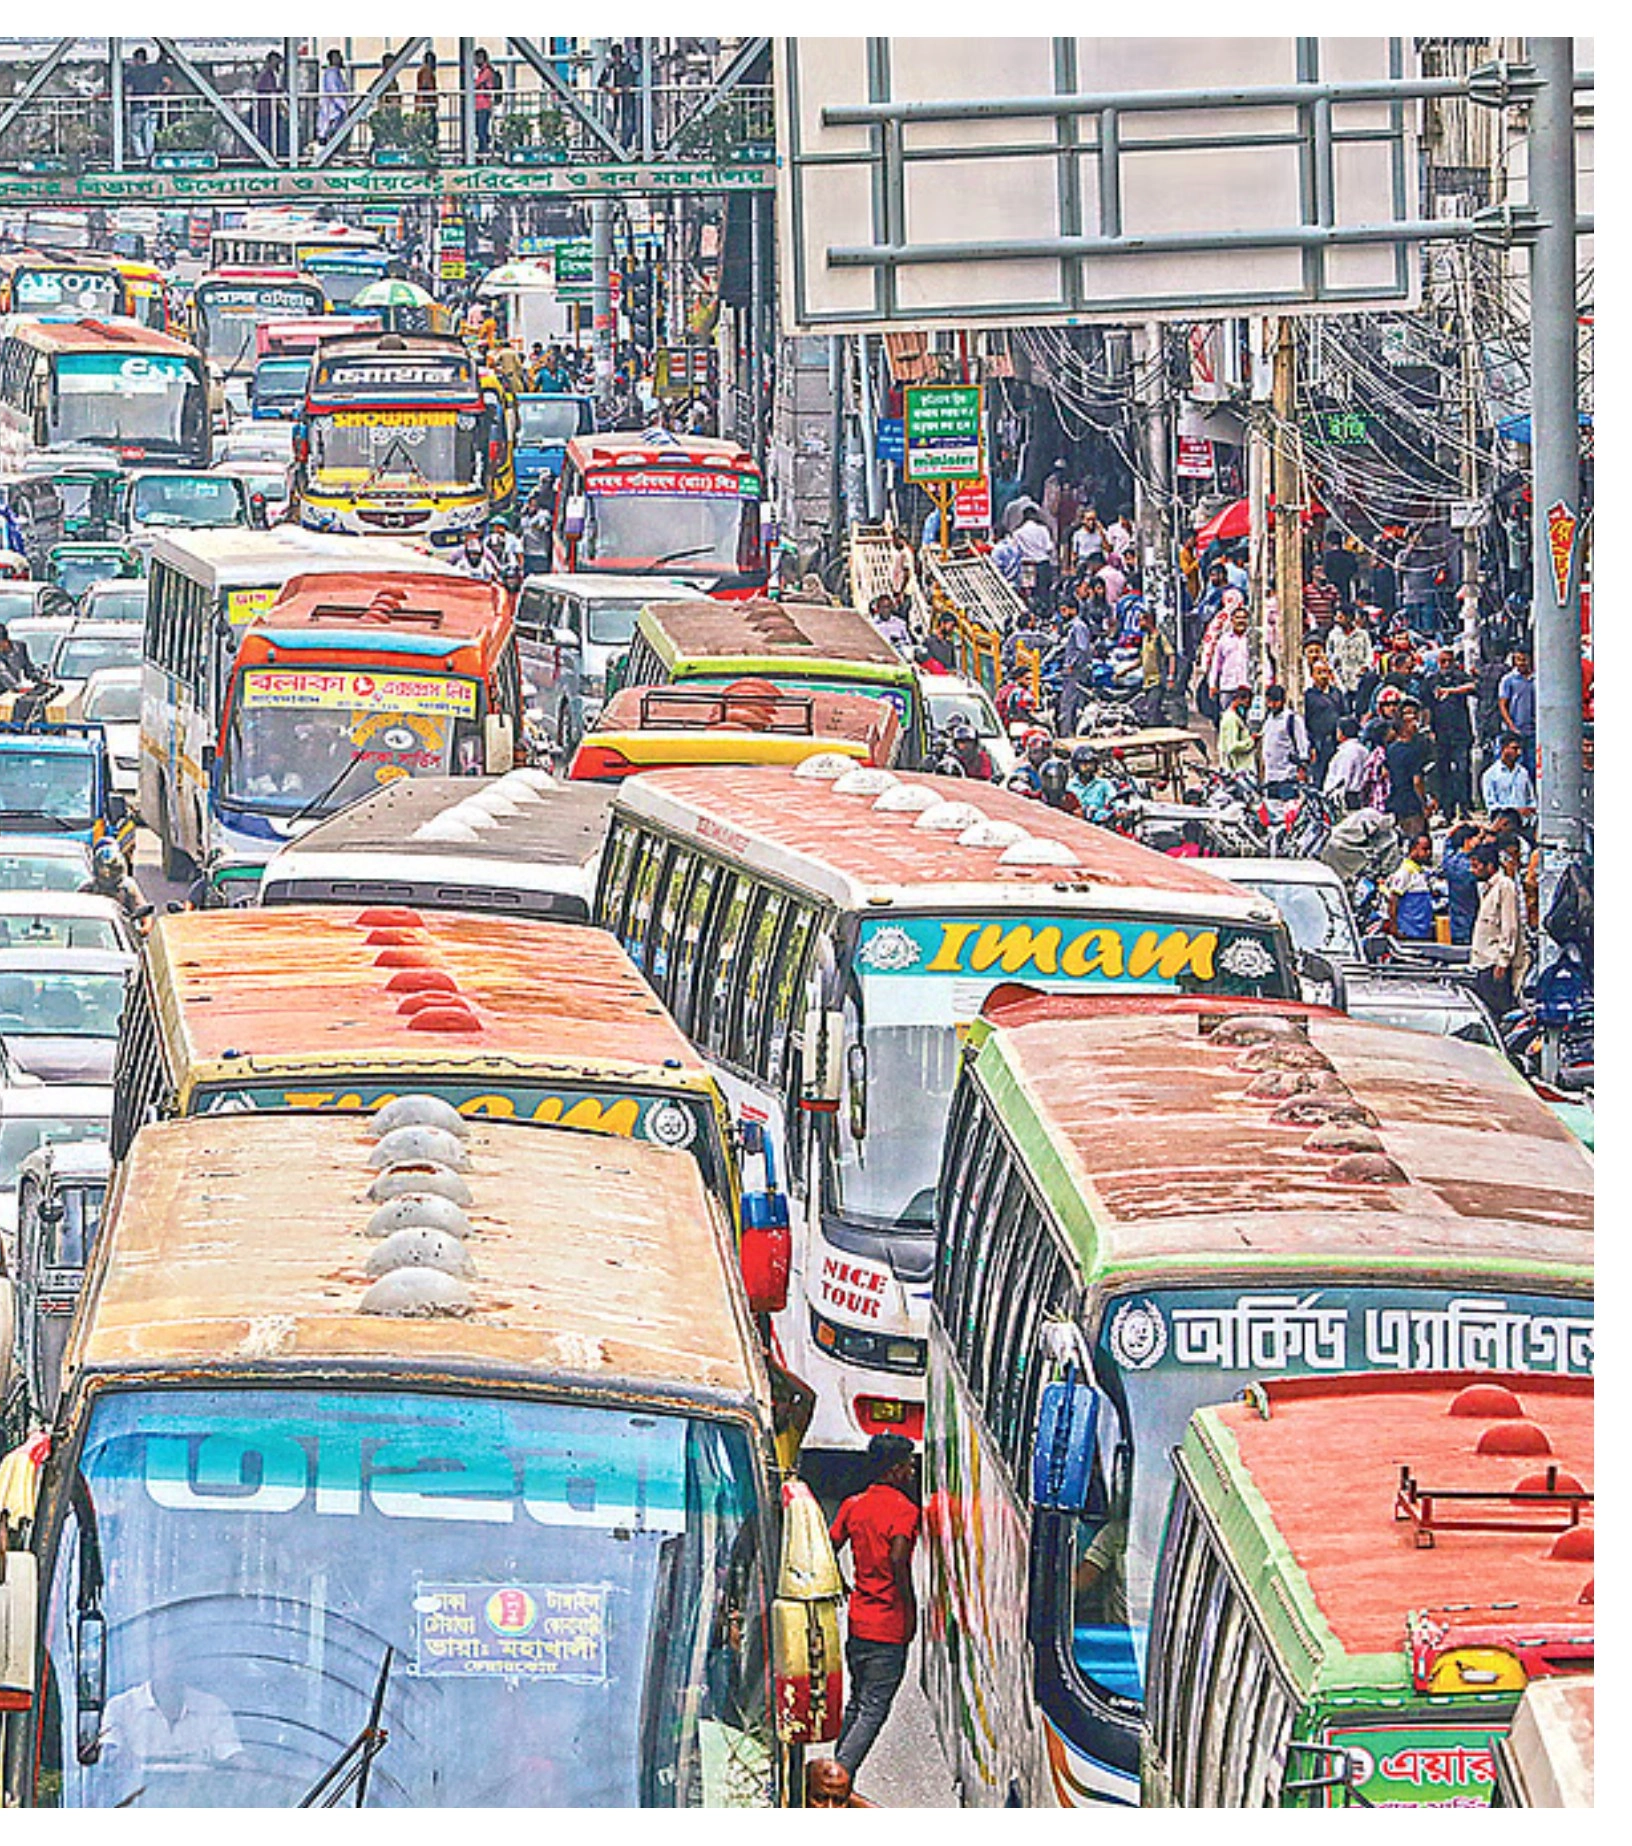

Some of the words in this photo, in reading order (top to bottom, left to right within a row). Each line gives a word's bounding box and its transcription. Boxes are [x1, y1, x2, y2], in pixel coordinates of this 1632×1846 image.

[292, 177, 313, 190] ও
[453, 170, 554, 189] পরিবেশ
[567, 171, 587, 187] ও
[600, 172, 637, 187] বন
[17, 272, 120, 294] AKOTA
[249, 673, 346, 692] বলাকা
[444, 680, 473, 700] লিঃ
[924, 922, 1219, 980] Imam
[822, 1257, 888, 1294] NICE
[821, 1280, 882, 1319] TOUR
[1171, 1292, 1349, 1370] অর্কিড
[497, 1635, 599, 1661] মহাখালী
[1380, 1746, 1498, 1785] এয়ার
